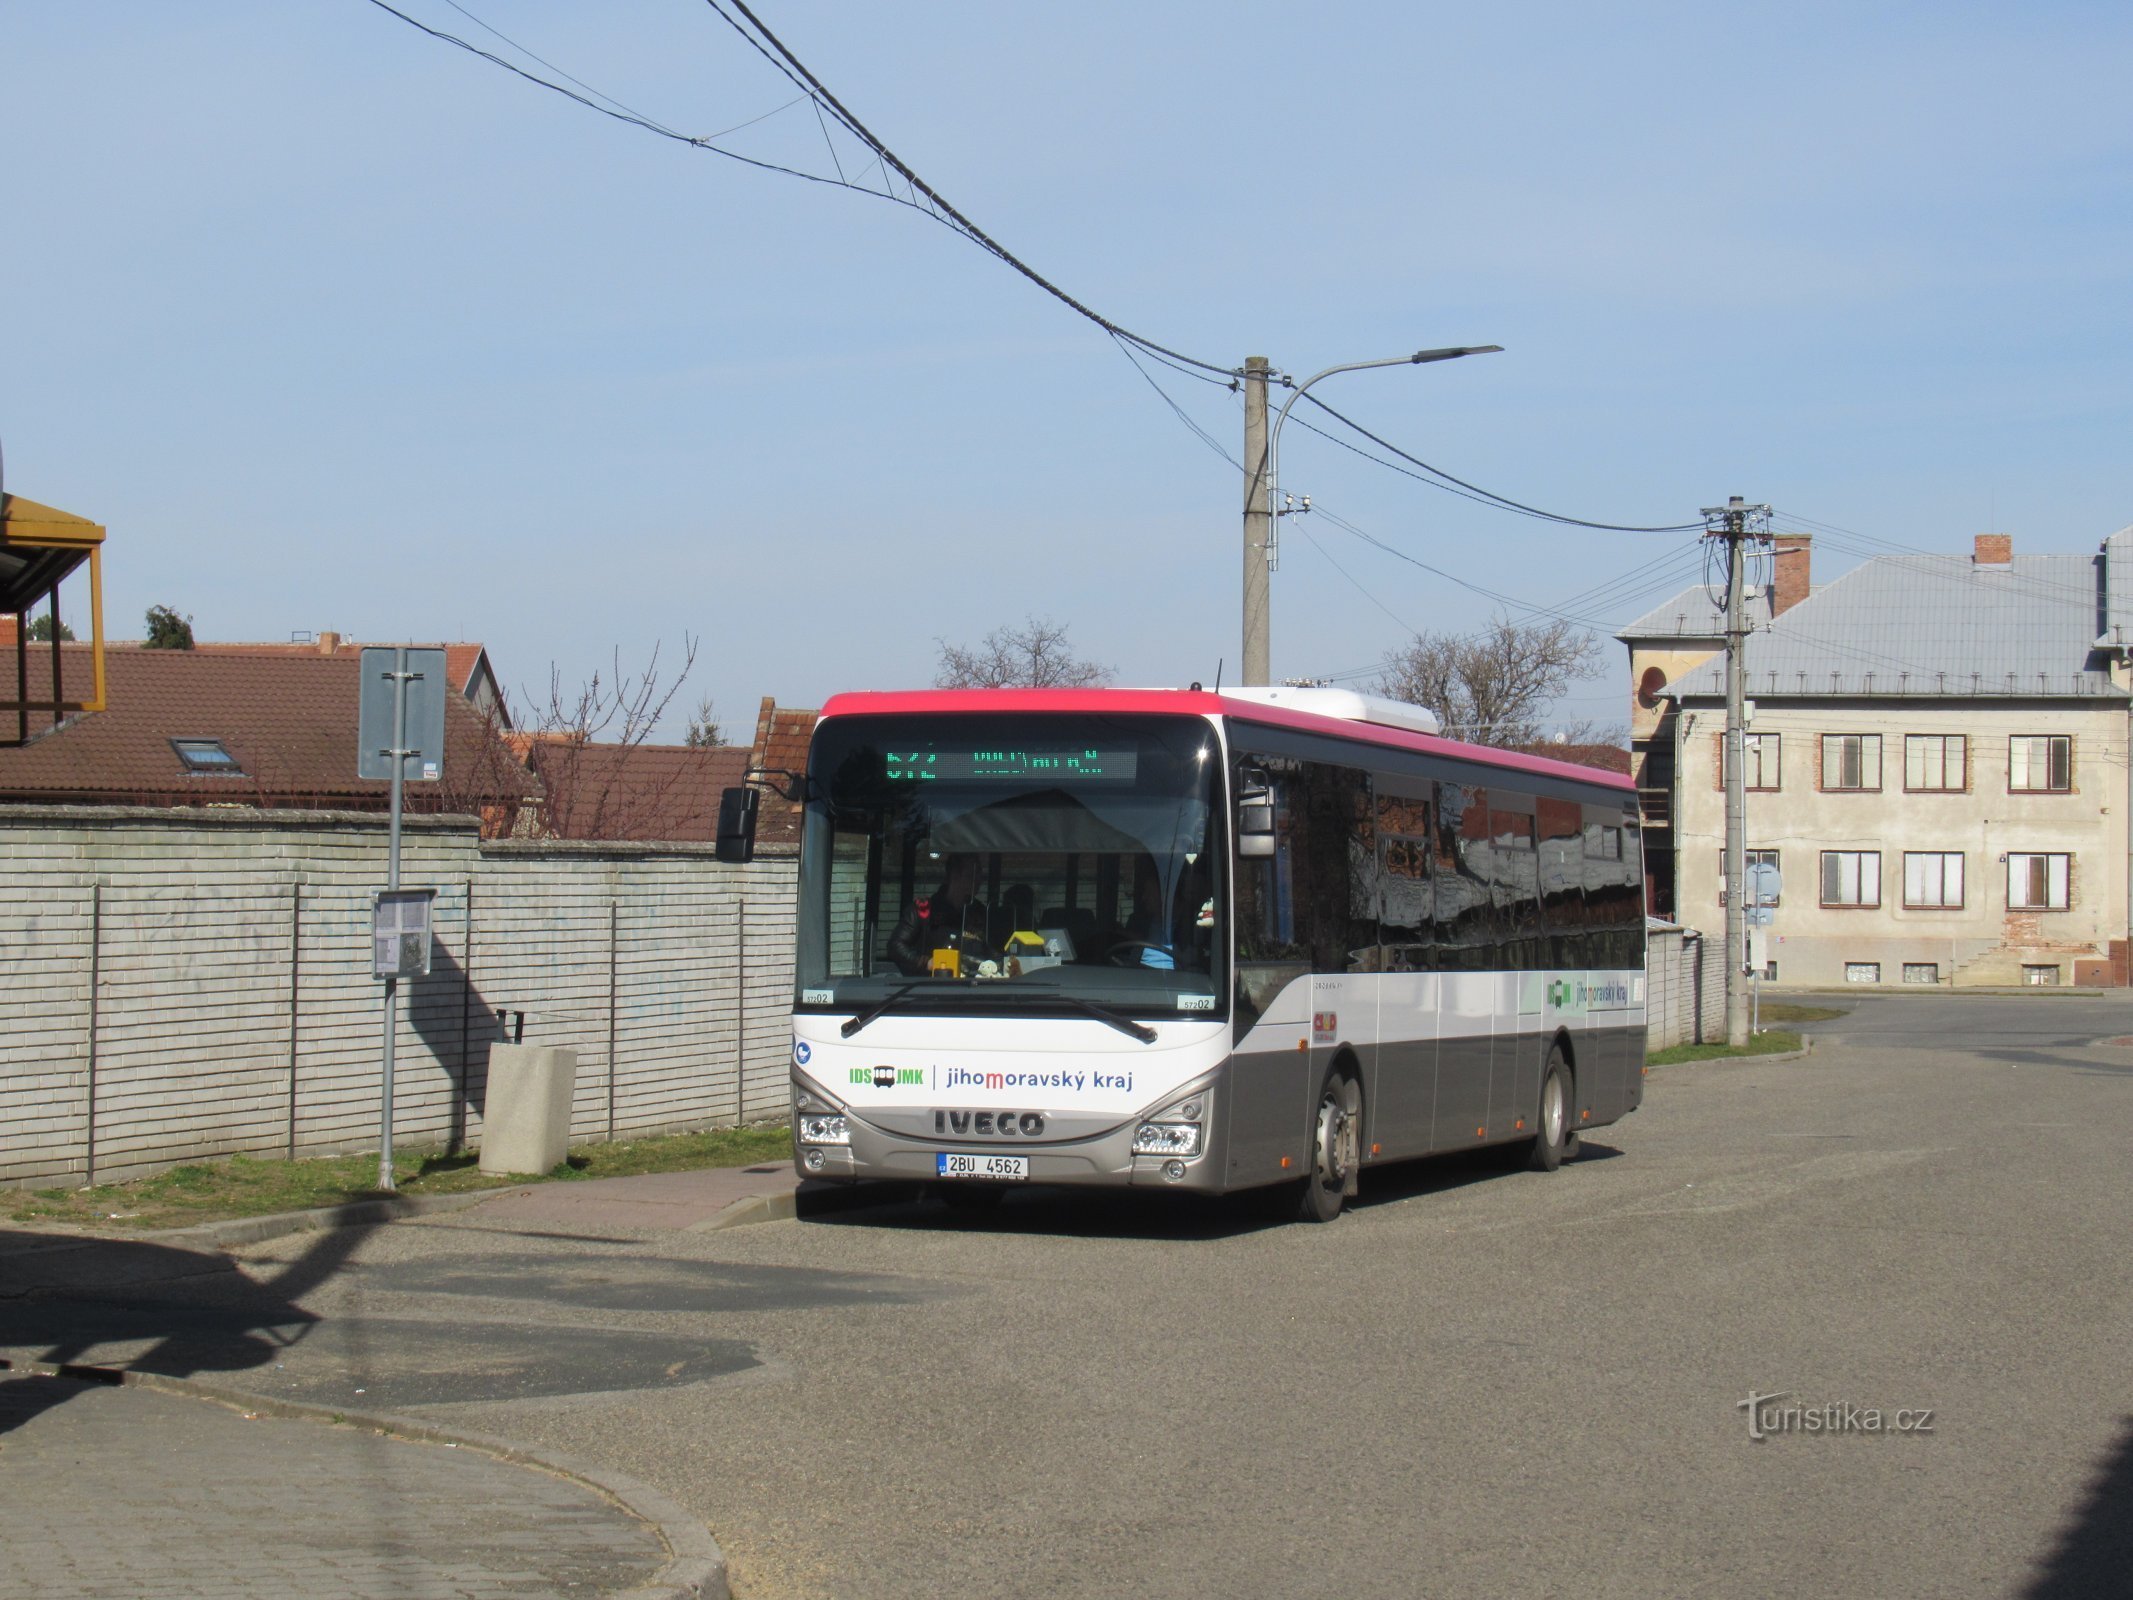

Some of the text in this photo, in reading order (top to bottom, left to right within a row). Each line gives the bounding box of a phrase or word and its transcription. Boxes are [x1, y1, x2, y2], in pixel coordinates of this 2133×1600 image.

[807, 993, 828, 1003] 57202
[1184, 999, 1210, 1009] 57202
[849, 1068, 924, 1085] IDS JMK
[946, 1067, 1133, 1092] jihomoravský kraj
[934, 1109, 1045, 1137] IVECO
[950, 1156, 1021, 1174] 2BU 4562
